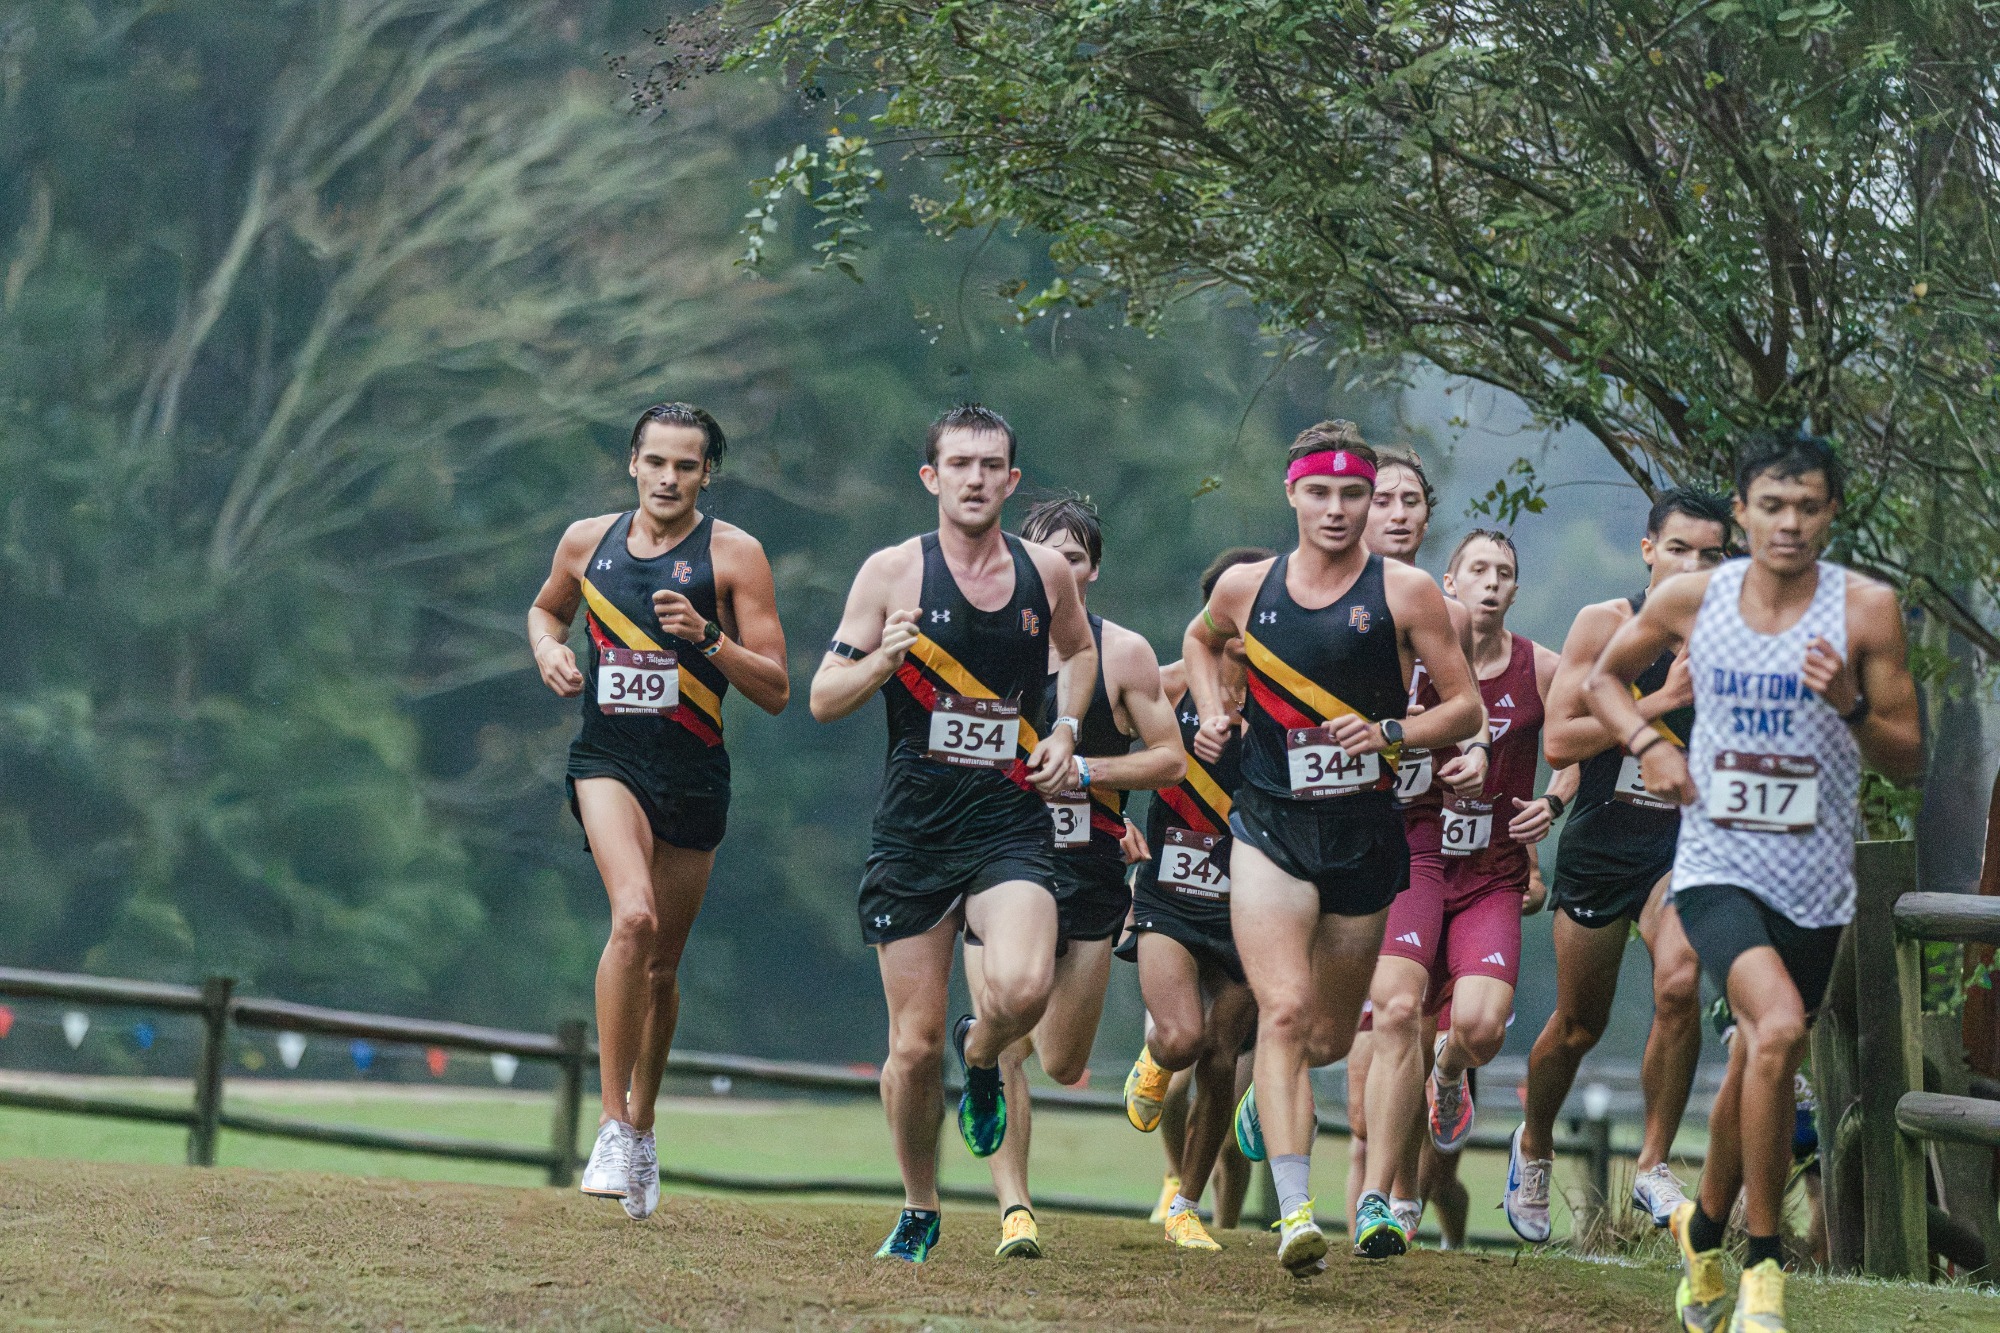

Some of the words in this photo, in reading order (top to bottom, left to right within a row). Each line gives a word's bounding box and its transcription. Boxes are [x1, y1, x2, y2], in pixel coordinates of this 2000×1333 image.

[672, 561, 692, 584] FC
[1020, 608, 1040, 636] FC
[1349, 605, 1370, 633] FC
[610, 673, 665, 701] 349
[943, 720, 1005, 752] 354
[1732, 706, 1794, 737] STATE
[1304, 751, 1365, 782] 344
[1727, 781, 1798, 815] 317
